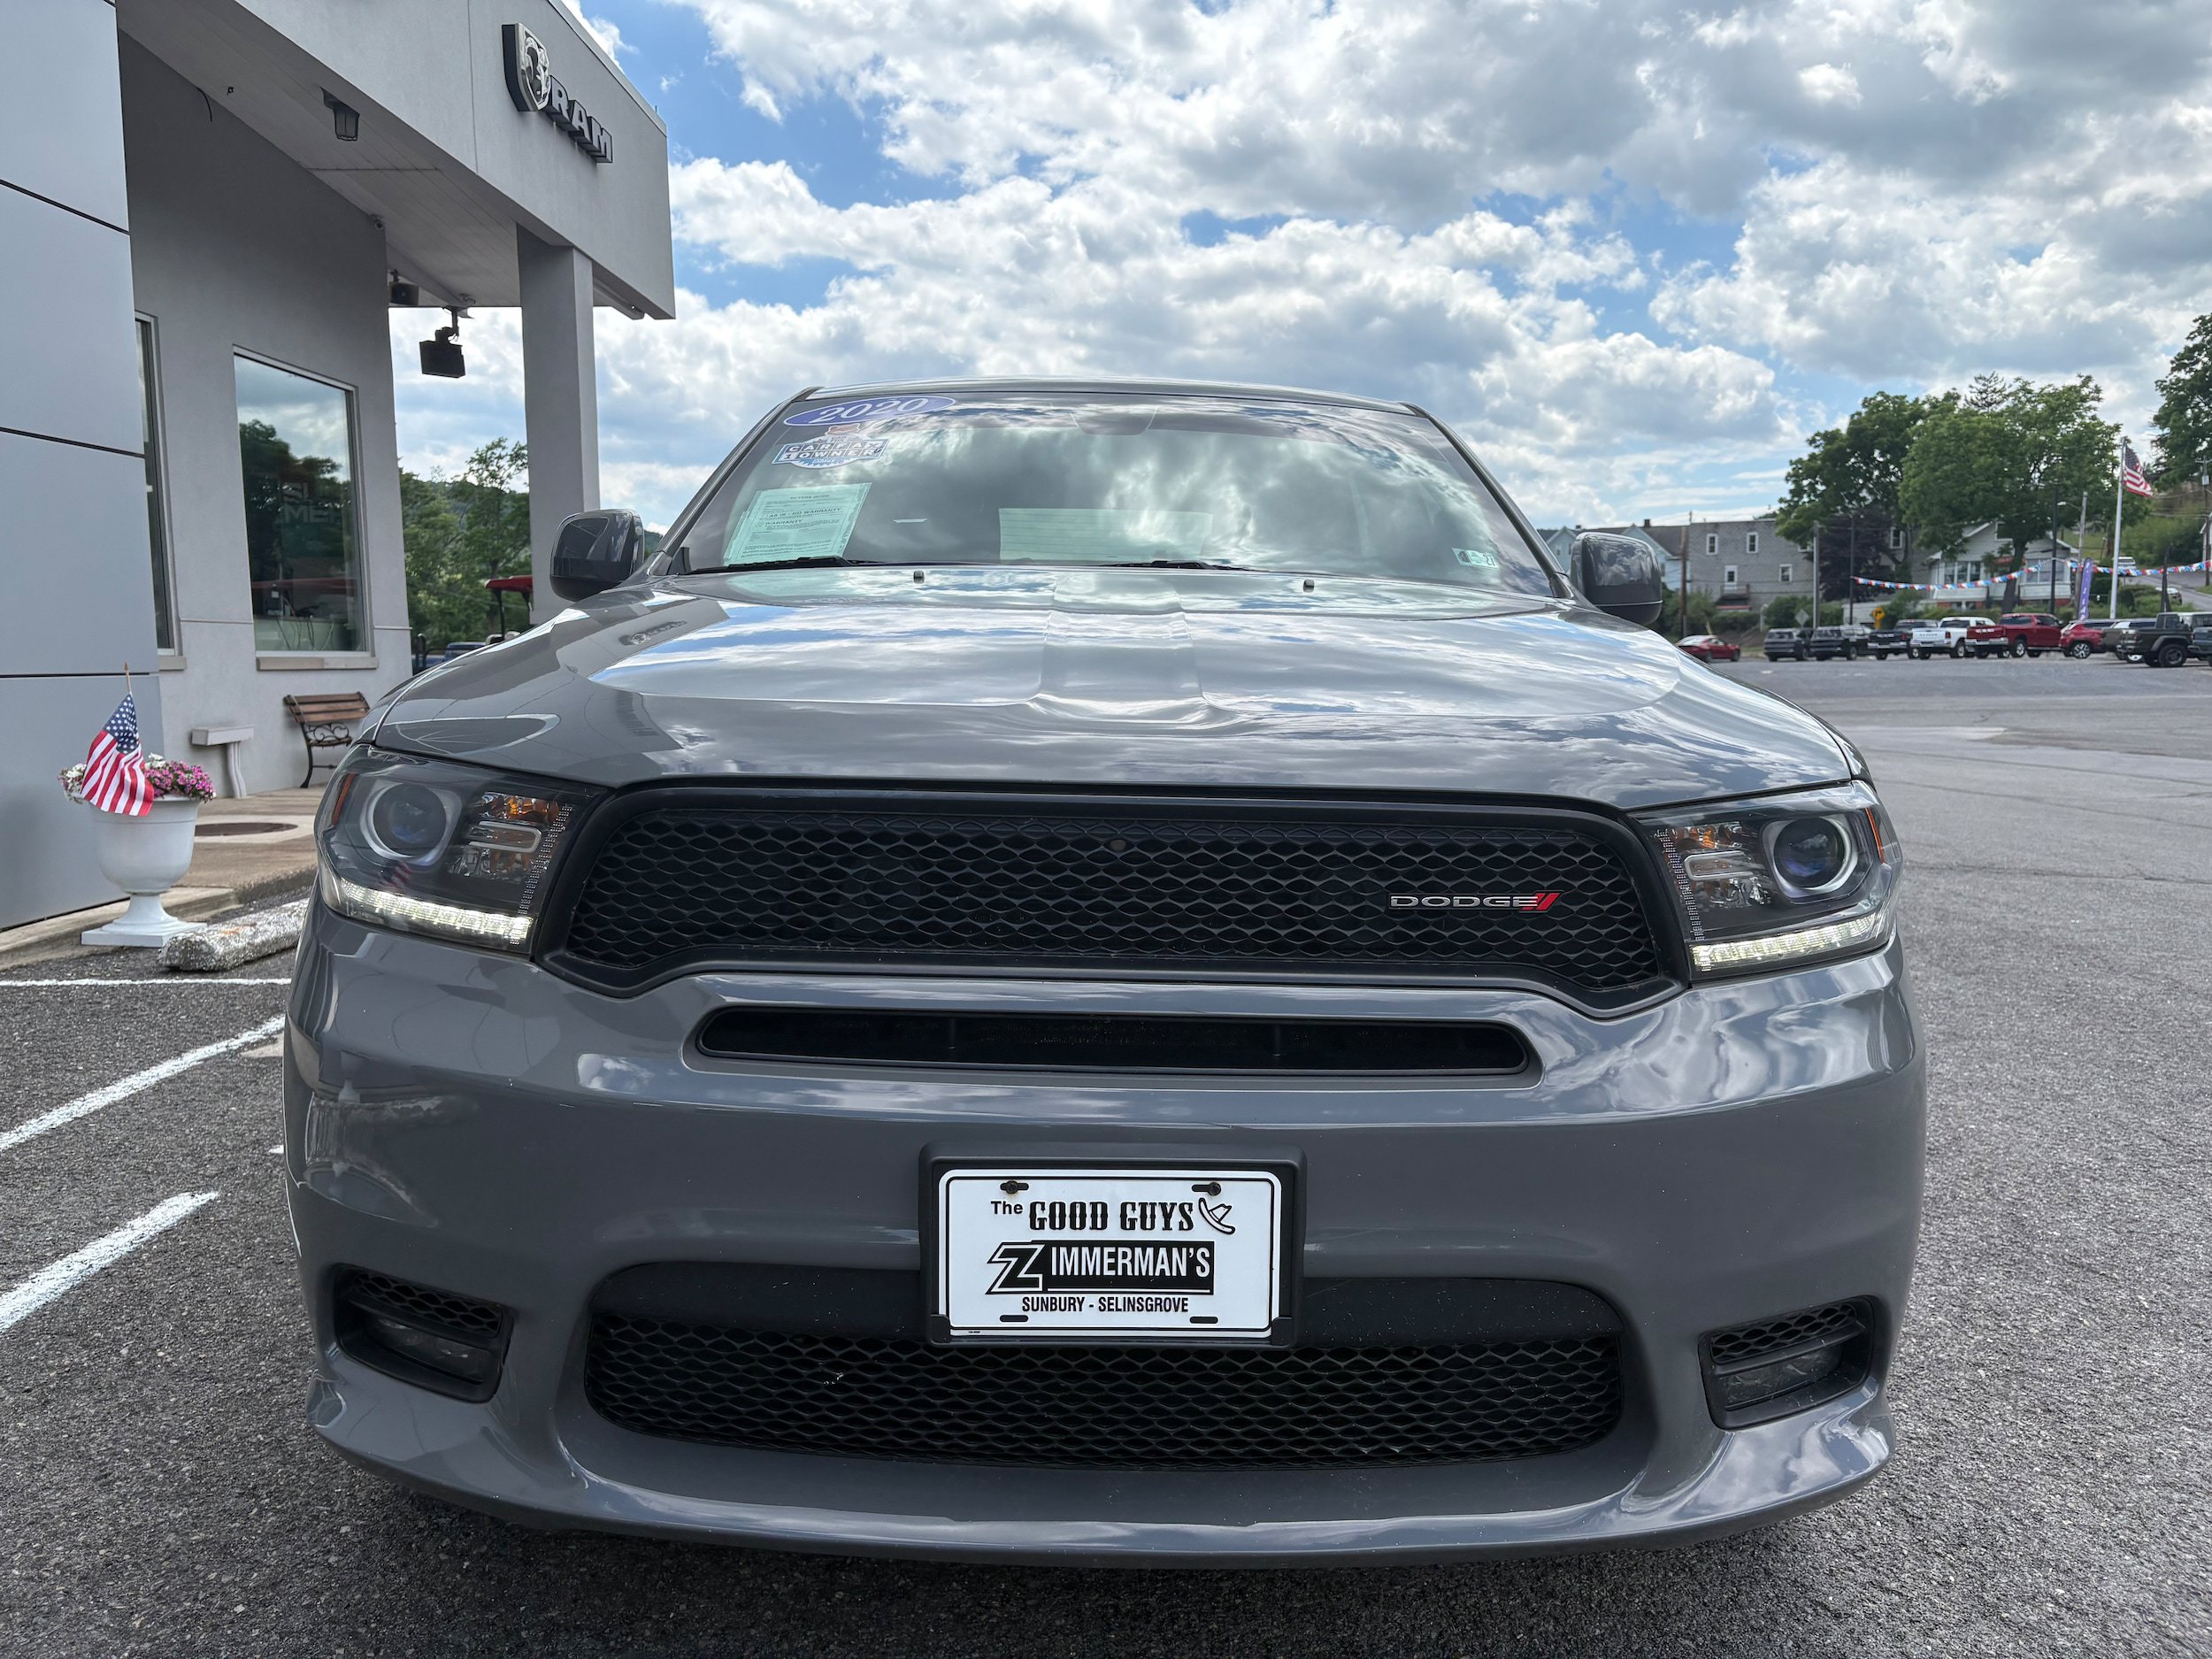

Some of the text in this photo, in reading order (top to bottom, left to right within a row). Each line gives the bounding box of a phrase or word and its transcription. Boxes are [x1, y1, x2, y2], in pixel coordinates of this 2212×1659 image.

[549, 75, 612, 162] RAM
[809, 398, 929, 424] 2020
[788, 441, 883, 452] CARFAX
[798, 449, 874, 458] OWNER
[1390, 895, 1538, 907] DODGE
[990, 1200, 1194, 1231] The GOOD GUYS
[986, 1242, 1211, 1294] ZIMMERMAN'S
[1022, 1296, 1086, 1312] SUNBURY
[1098, 1296, 1189, 1313] SELINSGROVE
